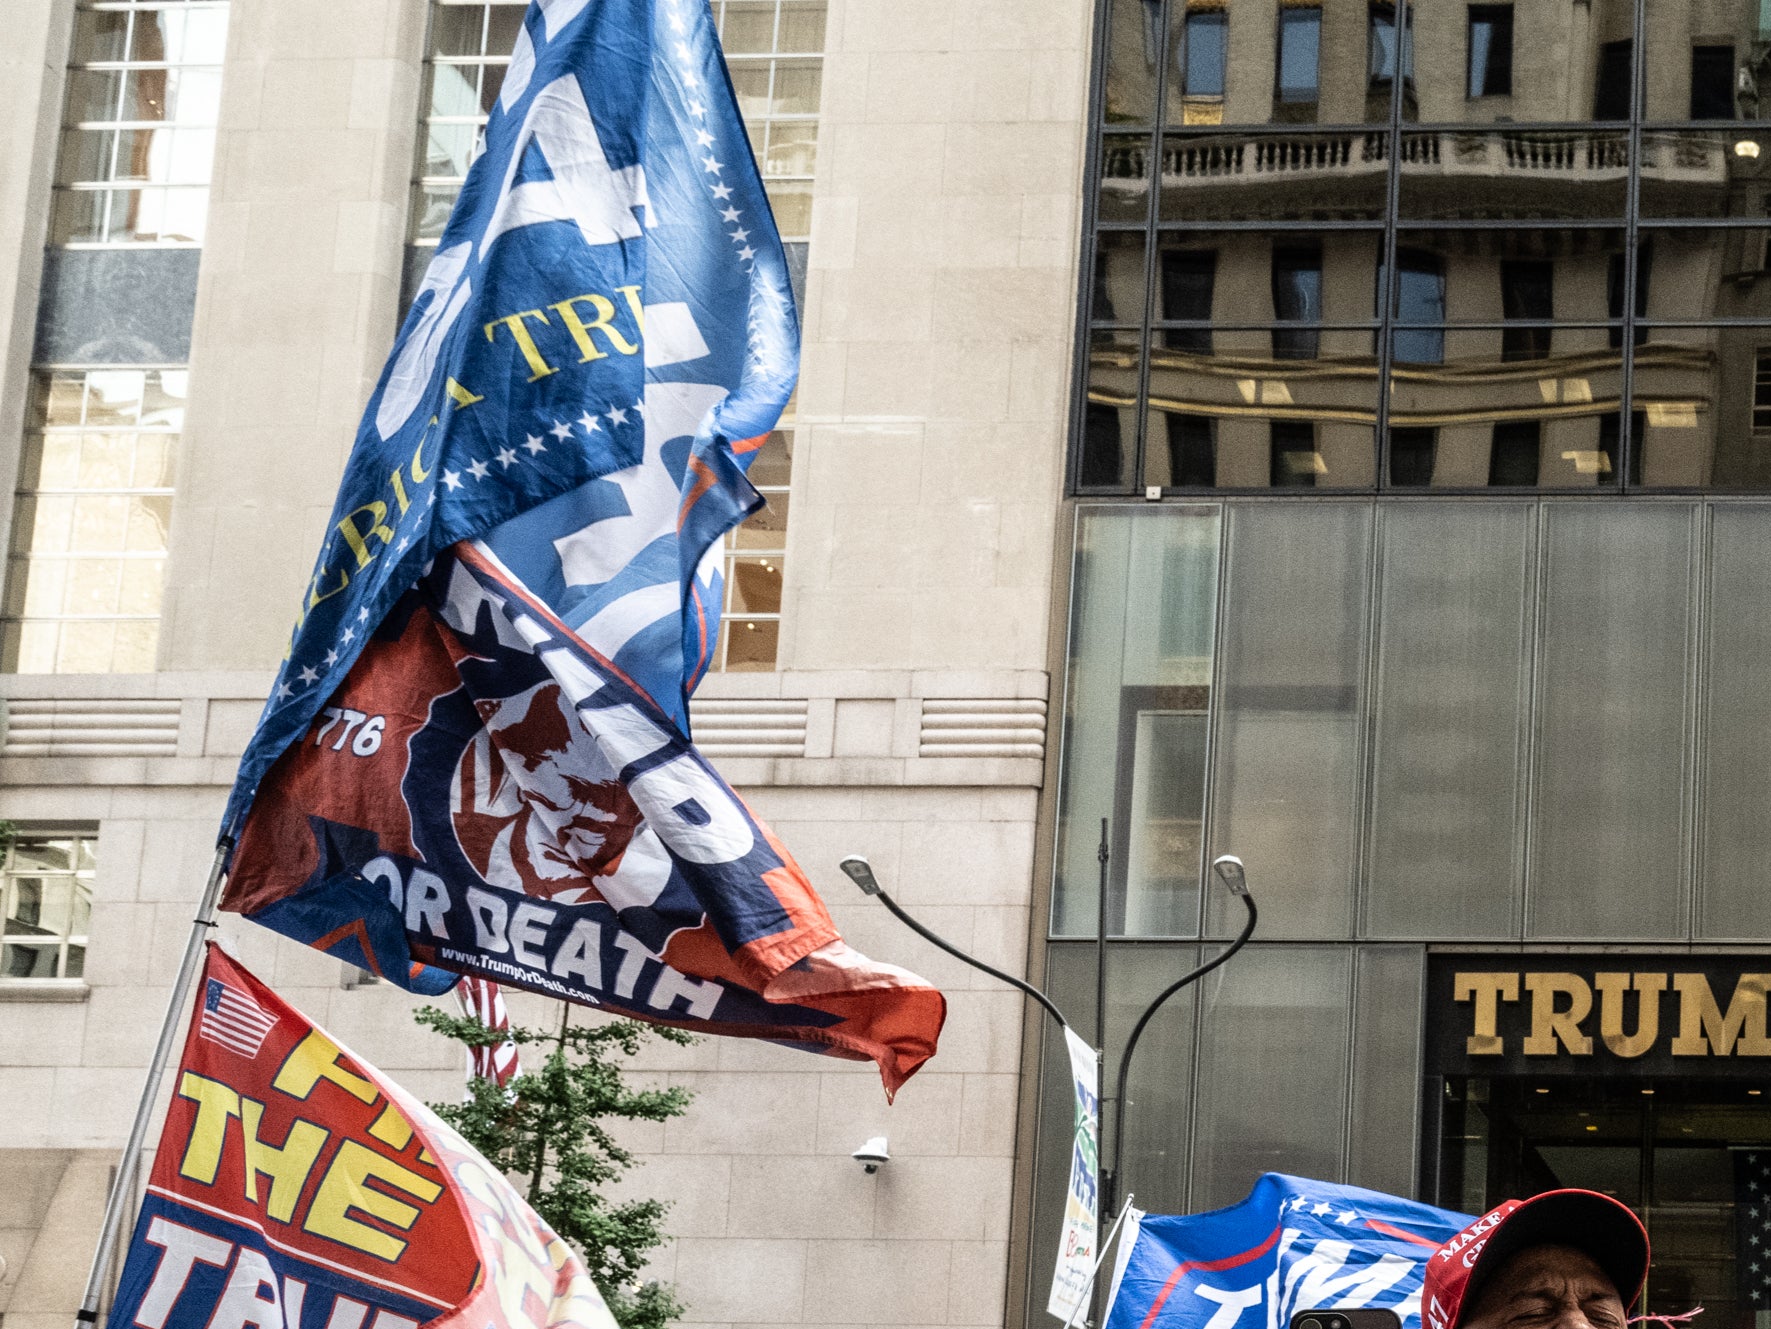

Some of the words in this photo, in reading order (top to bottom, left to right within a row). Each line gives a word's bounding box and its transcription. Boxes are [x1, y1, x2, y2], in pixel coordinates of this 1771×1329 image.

[314, 705, 385, 758] 776
[466, 884, 725, 1022] DEATH
[179, 1069, 445, 1263] THE
[1437, 1210, 1504, 1262] MAKE
